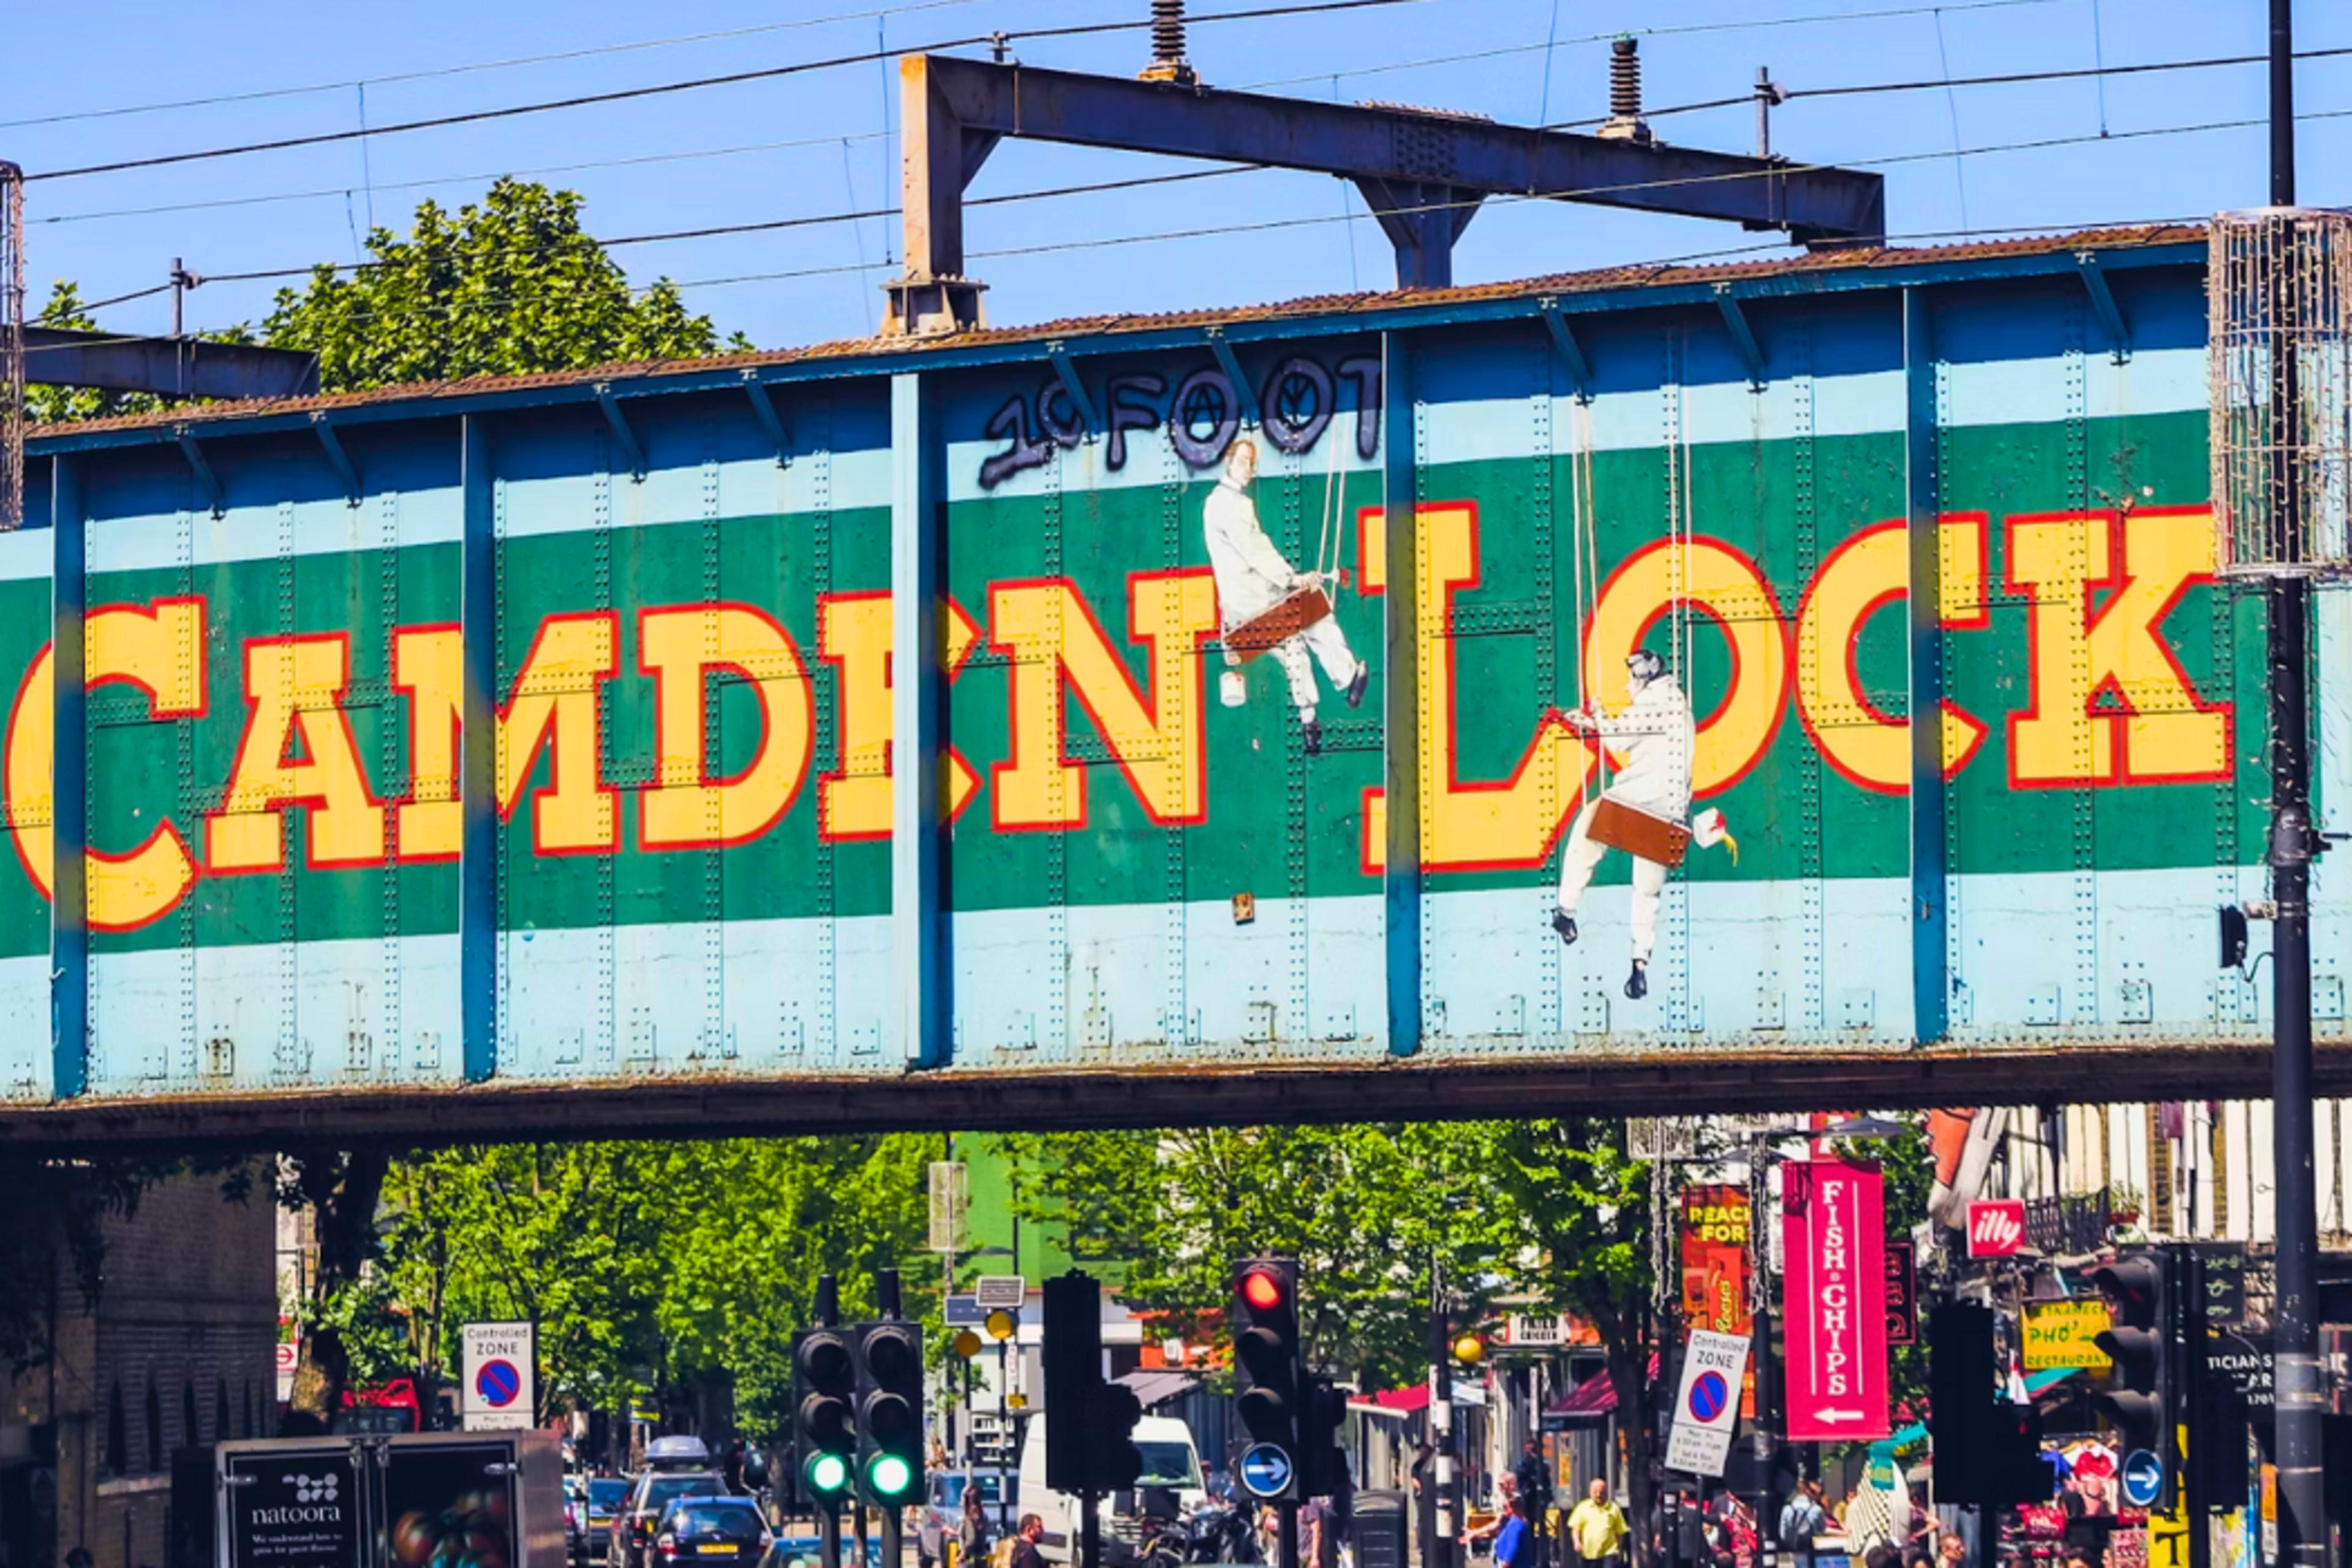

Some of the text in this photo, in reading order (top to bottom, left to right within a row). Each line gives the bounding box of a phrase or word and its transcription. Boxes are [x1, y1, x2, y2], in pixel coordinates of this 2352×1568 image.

[3, 499, 2236, 932] CAMDEN LOCK
[1702, 1224, 1746, 1242] FOR
[1822, 1180, 1846, 1270] FISH
[1975, 1209, 2021, 1250] illy
[467, 1328, 528, 1339] Controlled
[1693, 1334, 1746, 1352] Controlled
[1821, 1284, 1848, 1397] CHIPS
[476, 1342, 518, 1355] ZONE
[1697, 1350, 1734, 1369] ZONE
[2206, 1354, 2273, 1370] TICIANS
[251, 1506, 341, 1525] natoora
